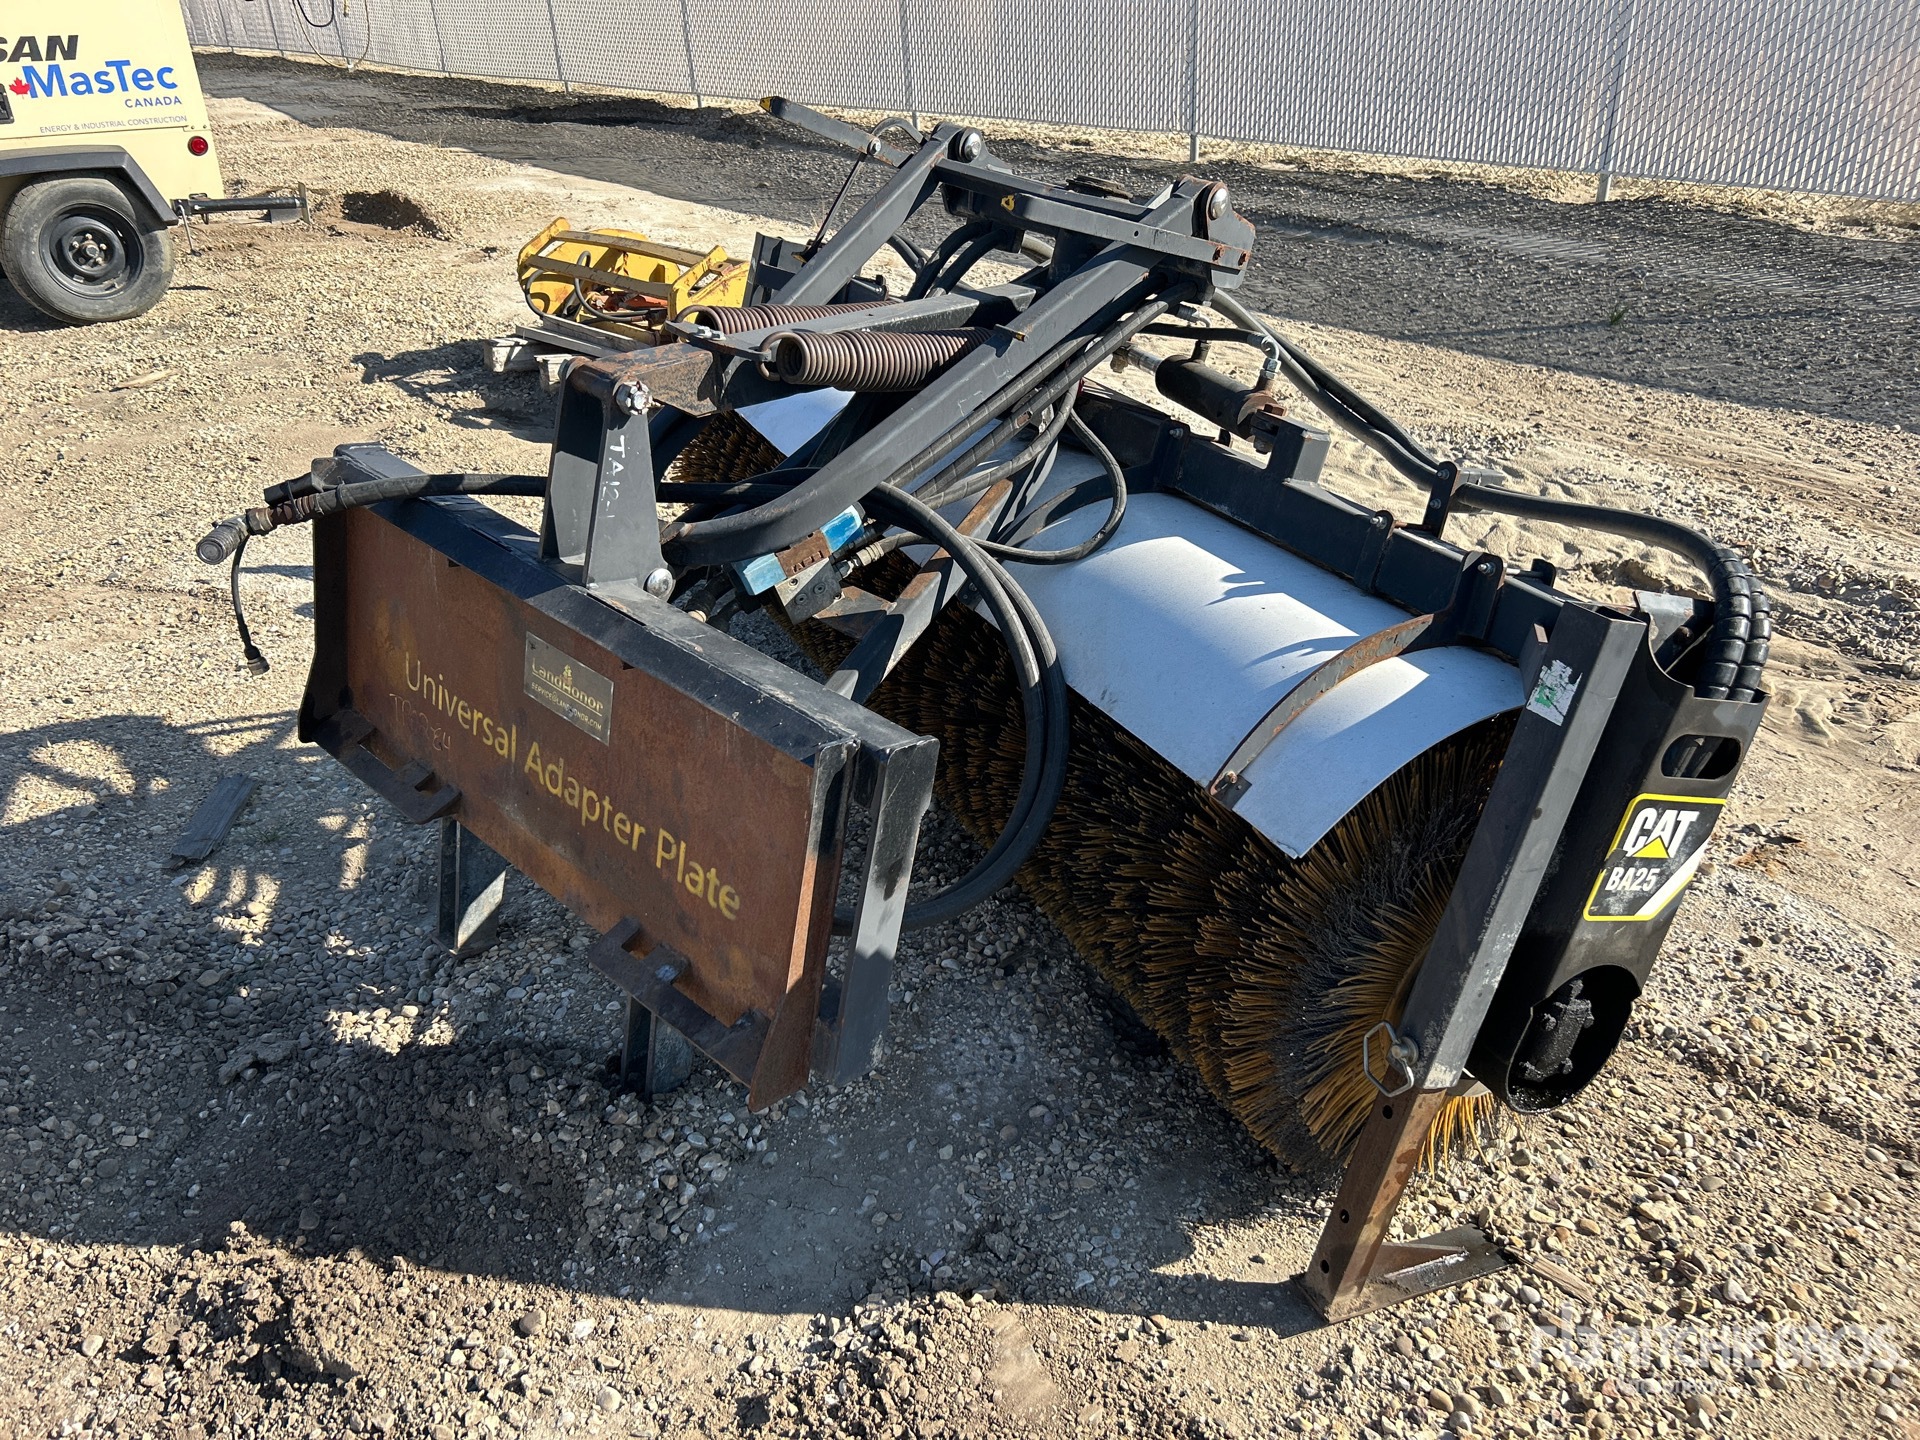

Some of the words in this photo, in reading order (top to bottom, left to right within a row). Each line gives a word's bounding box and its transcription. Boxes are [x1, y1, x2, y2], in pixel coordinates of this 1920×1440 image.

[22, 60, 178, 98] MasTec
[124, 96, 182, 108] CANADA
[40, 124, 72, 134] ENERGY
[74, 123, 80, 131] &
[81, 120, 126, 130] INDUSTRIAL
[127, 115, 188, 126] CONSTRUCTION
[531, 657, 604, 713] LandHonor
[405, 651, 517, 763] Universal
[524, 741, 646, 852] Adapter
[655, 827, 740, 920] Plate
[1622, 807, 1700, 859] CAT
[1605, 866, 1661, 892] BA25
